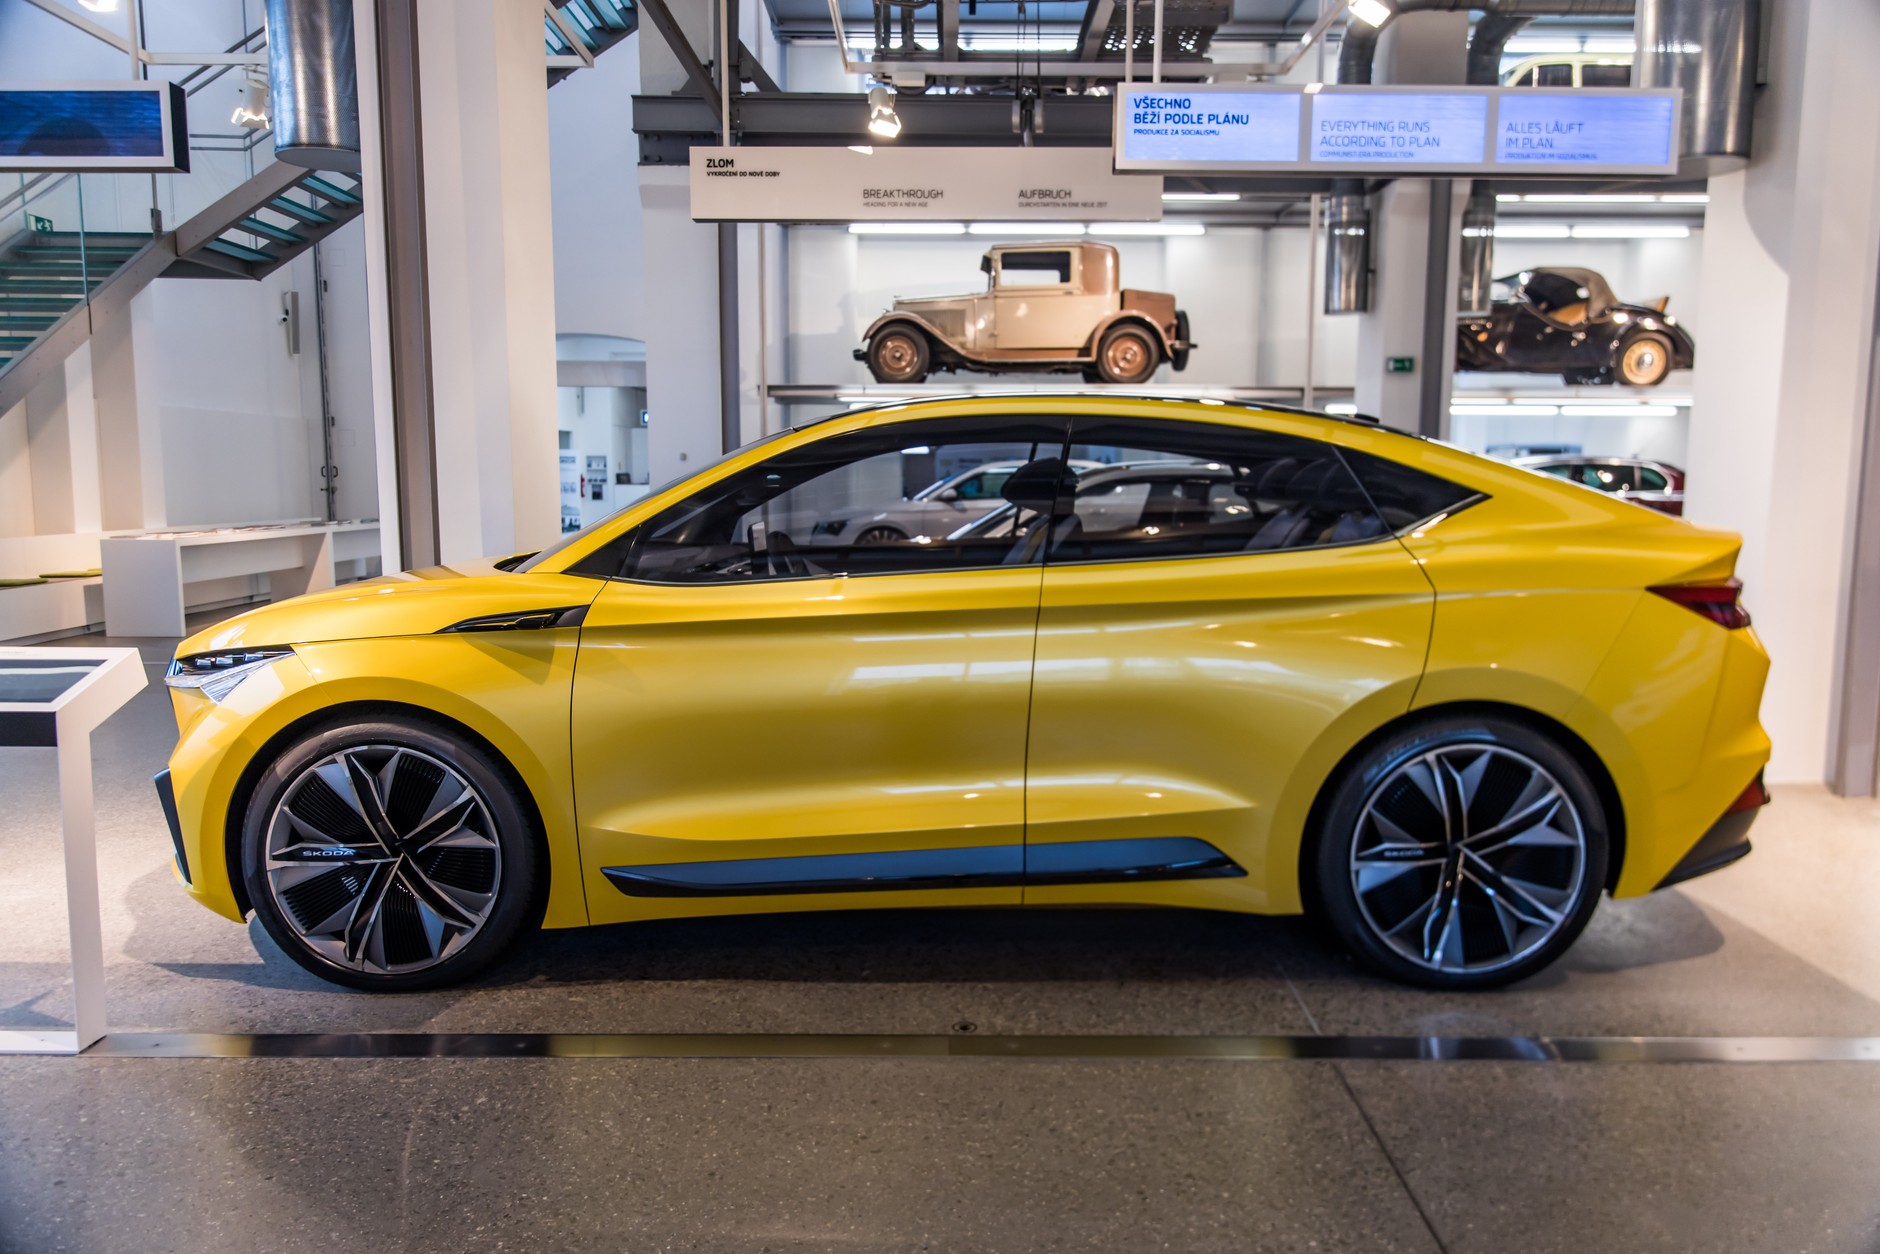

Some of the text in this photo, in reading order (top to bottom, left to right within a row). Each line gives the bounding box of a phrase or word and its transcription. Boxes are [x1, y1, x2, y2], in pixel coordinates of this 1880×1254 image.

[1133, 96, 1191, 109] VŠECHNO
[1134, 111, 1249, 125] BĚŽÍ PODLE PLÁNU
[1320, 120, 1430, 133] EVERYTHING RUNS
[1506, 122, 1542, 134] ALLES
[1320, 135, 1440, 148] ACCORDING TO PLAN
[1506, 138, 1553, 149] IM PLAN
[706, 158, 734, 168] ZLOM
[863, 189, 944, 199] BREAKTHROUGH
[1018, 189, 1072, 199] AUFBRUCH
